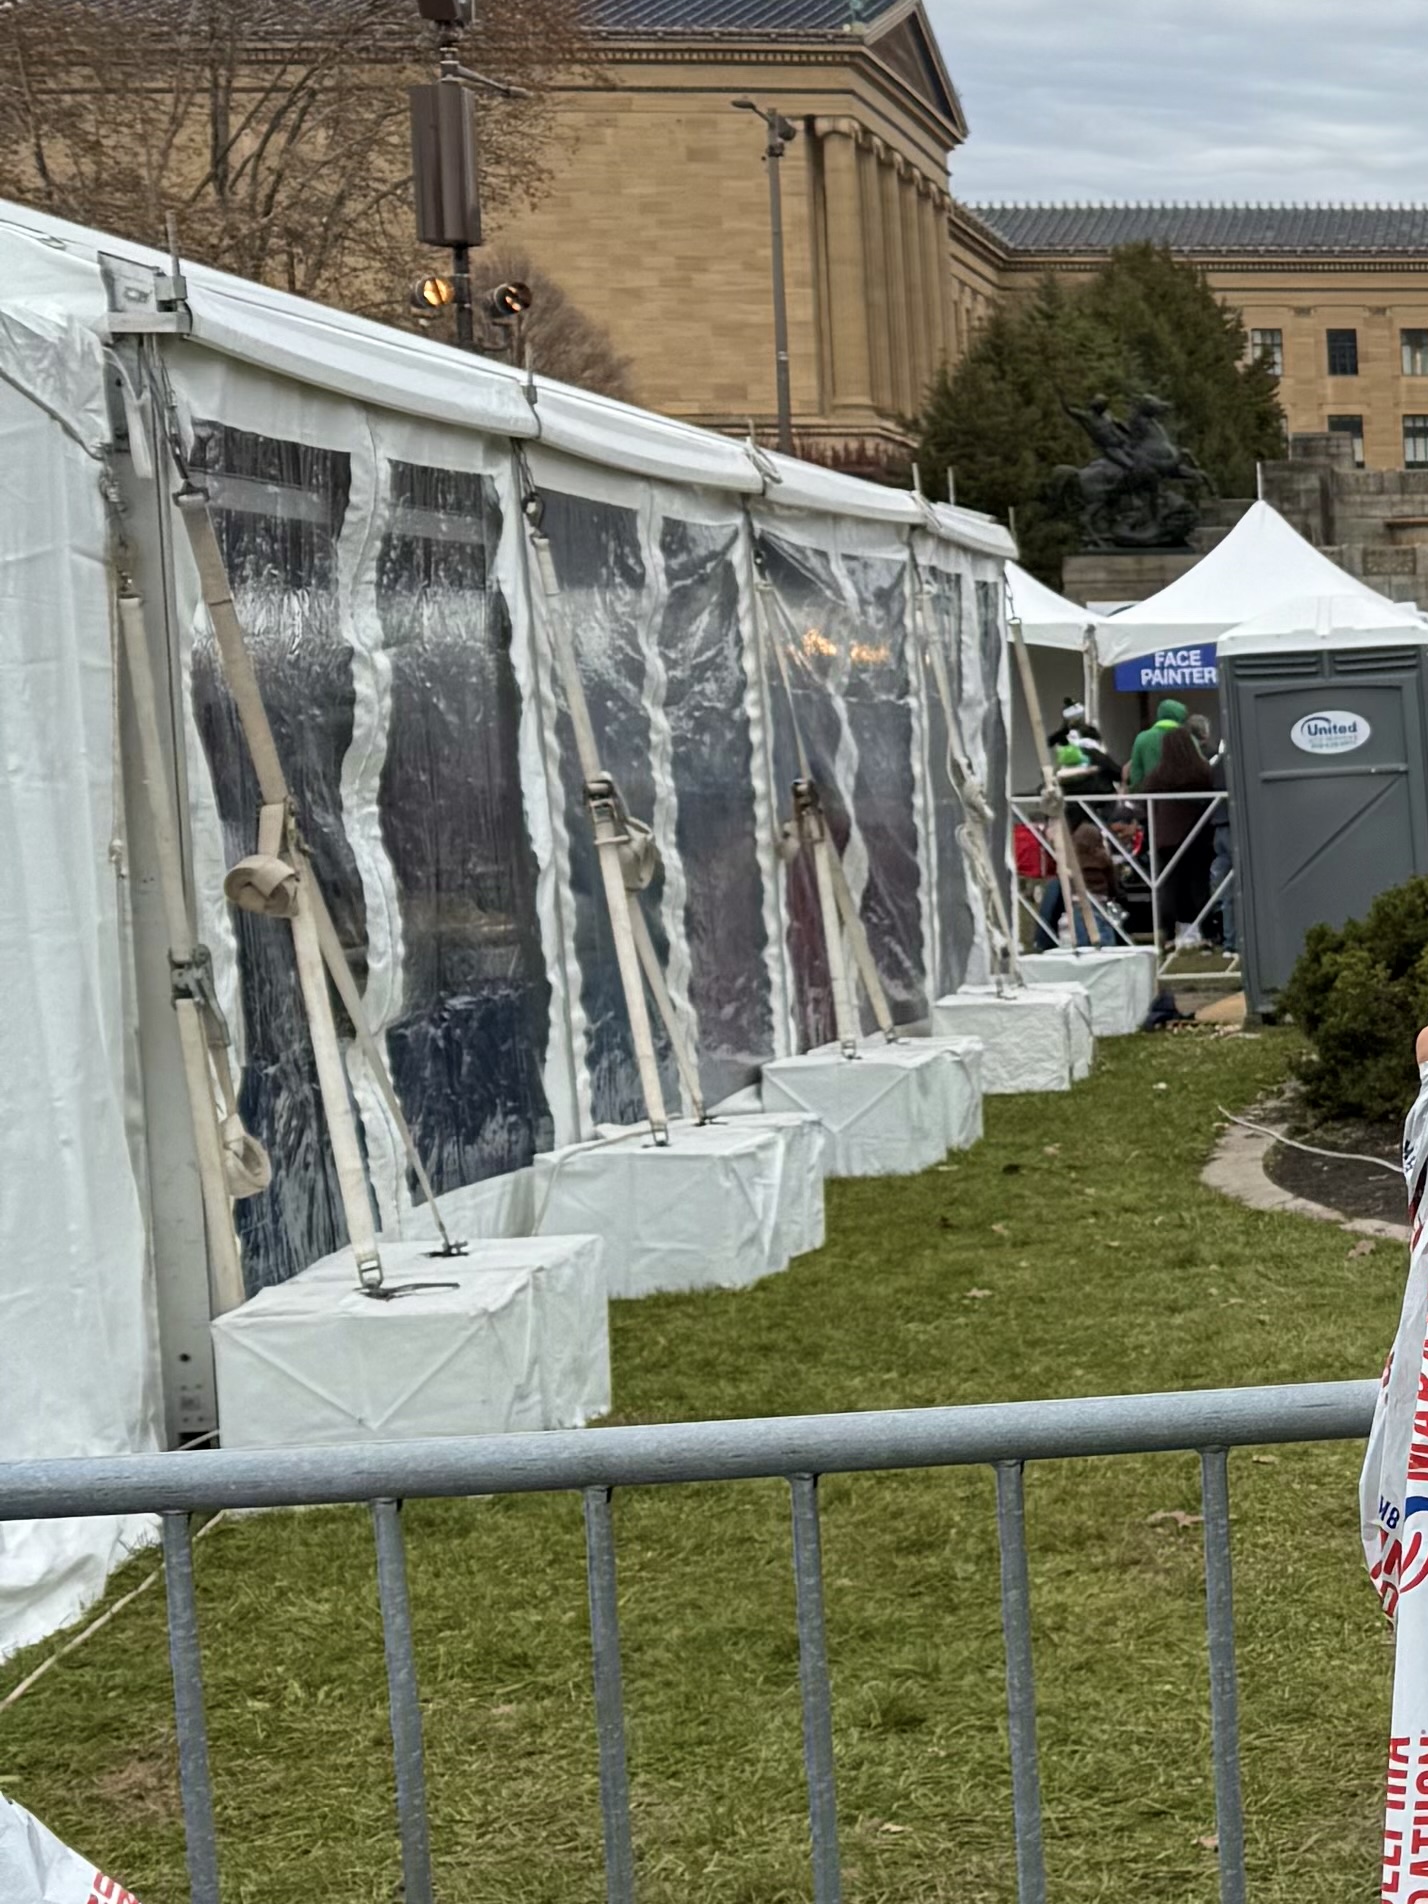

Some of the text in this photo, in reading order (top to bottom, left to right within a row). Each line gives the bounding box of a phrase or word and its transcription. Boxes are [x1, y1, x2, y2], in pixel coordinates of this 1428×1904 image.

[1154, 649, 1201, 667] FACE
[1140, 667, 1217, 686] PAINTER
[1307, 721, 1358, 736] United
